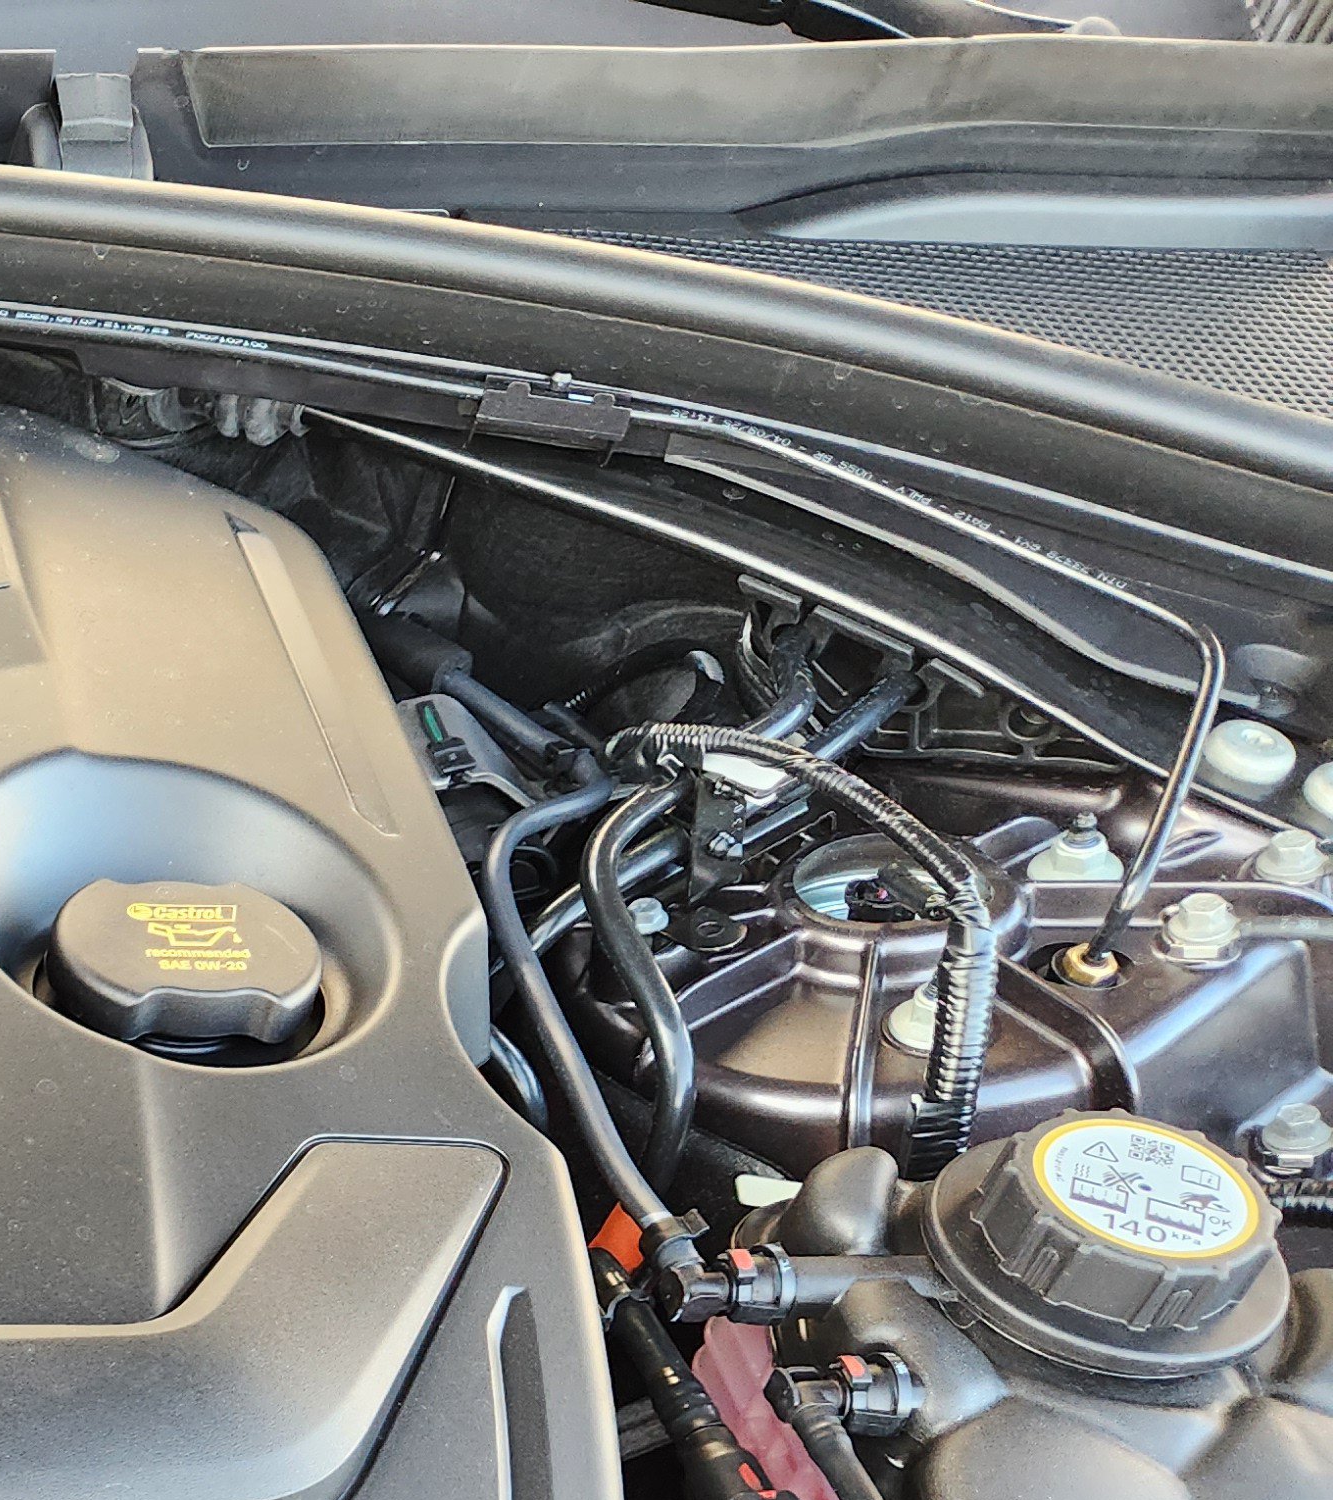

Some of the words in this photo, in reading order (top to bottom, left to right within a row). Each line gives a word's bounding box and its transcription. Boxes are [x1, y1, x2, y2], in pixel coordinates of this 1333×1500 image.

[152, 906, 224, 921] Castrol
[146, 947, 251, 958] recommended
[160, 960, 191, 970] SAE
[195, 960, 247, 971] 0W-20
[1101, 1212, 1168, 1243] 140
[1209, 1215, 1233, 1230] OK
